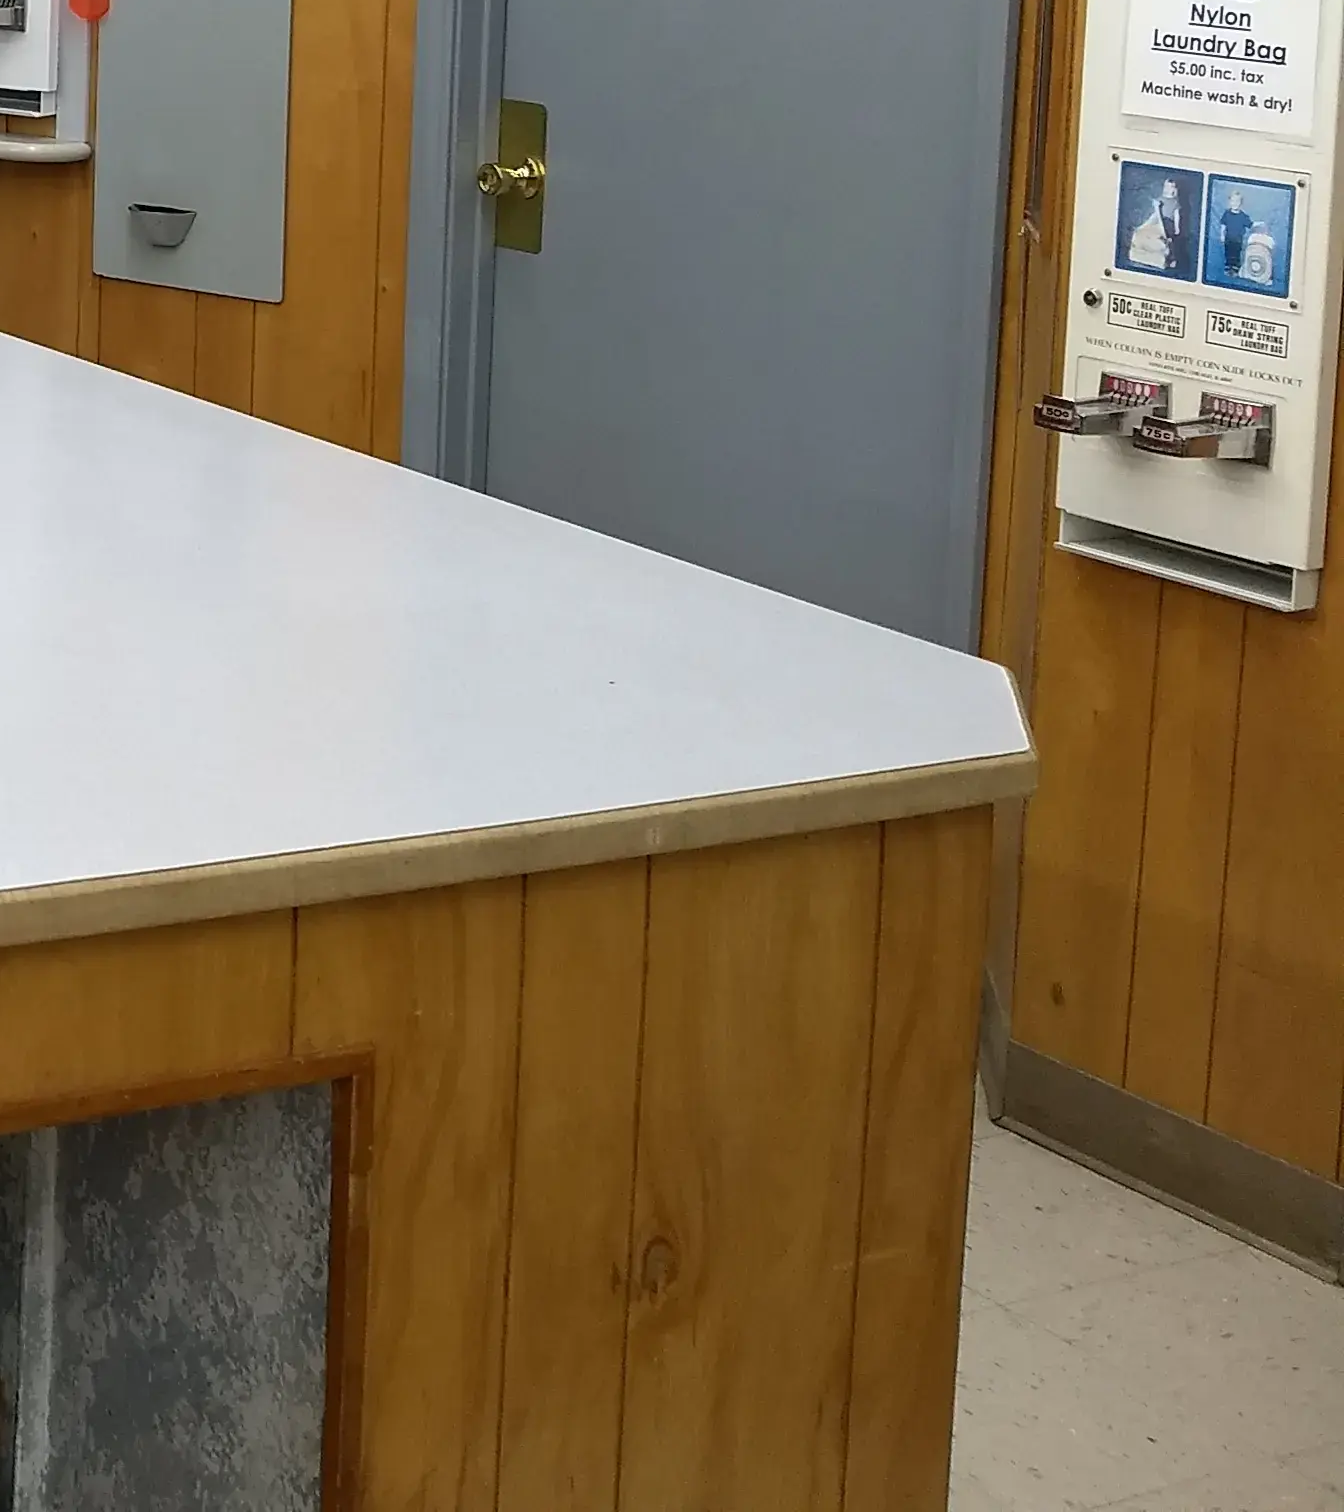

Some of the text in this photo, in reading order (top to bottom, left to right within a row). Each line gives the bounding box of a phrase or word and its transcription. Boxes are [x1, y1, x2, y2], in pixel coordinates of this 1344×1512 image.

[1191, 3, 1252, 28] Nylon
[1154, 29, 1287, 65] Laundry Bag
[1170, 60, 1264, 84] $5.00 inc. tax
[1141, 81, 1292, 114] Machine wash & dry!
[1141, 302, 1156, 312] REAL
[1160, 306, 1174, 314] TUFF
[1133, 310, 1181, 325] CLEAR PLASTIC
[1137, 320, 1180, 334] LAUNDRY BAG
[1242, 320, 1258, 331] REAL
[1260, 324, 1276, 334] TUFF
[1232, 328, 1284, 345] DRAW STRING
[1241, 340, 1283, 354] LAUNDRY BAG
[1085, 336, 1112, 350] WHEN
[1114, 342, 1152, 358] COLUMN
[1155, 350, 1162, 359] IS
[1165, 352, 1194, 365] EMPTY
[1197, 359, 1220, 371] COIN
[1222, 364, 1245, 376] SLIDE
[1249, 370, 1280, 383] LOCKS
[1282, 377, 1302, 388] OUT
